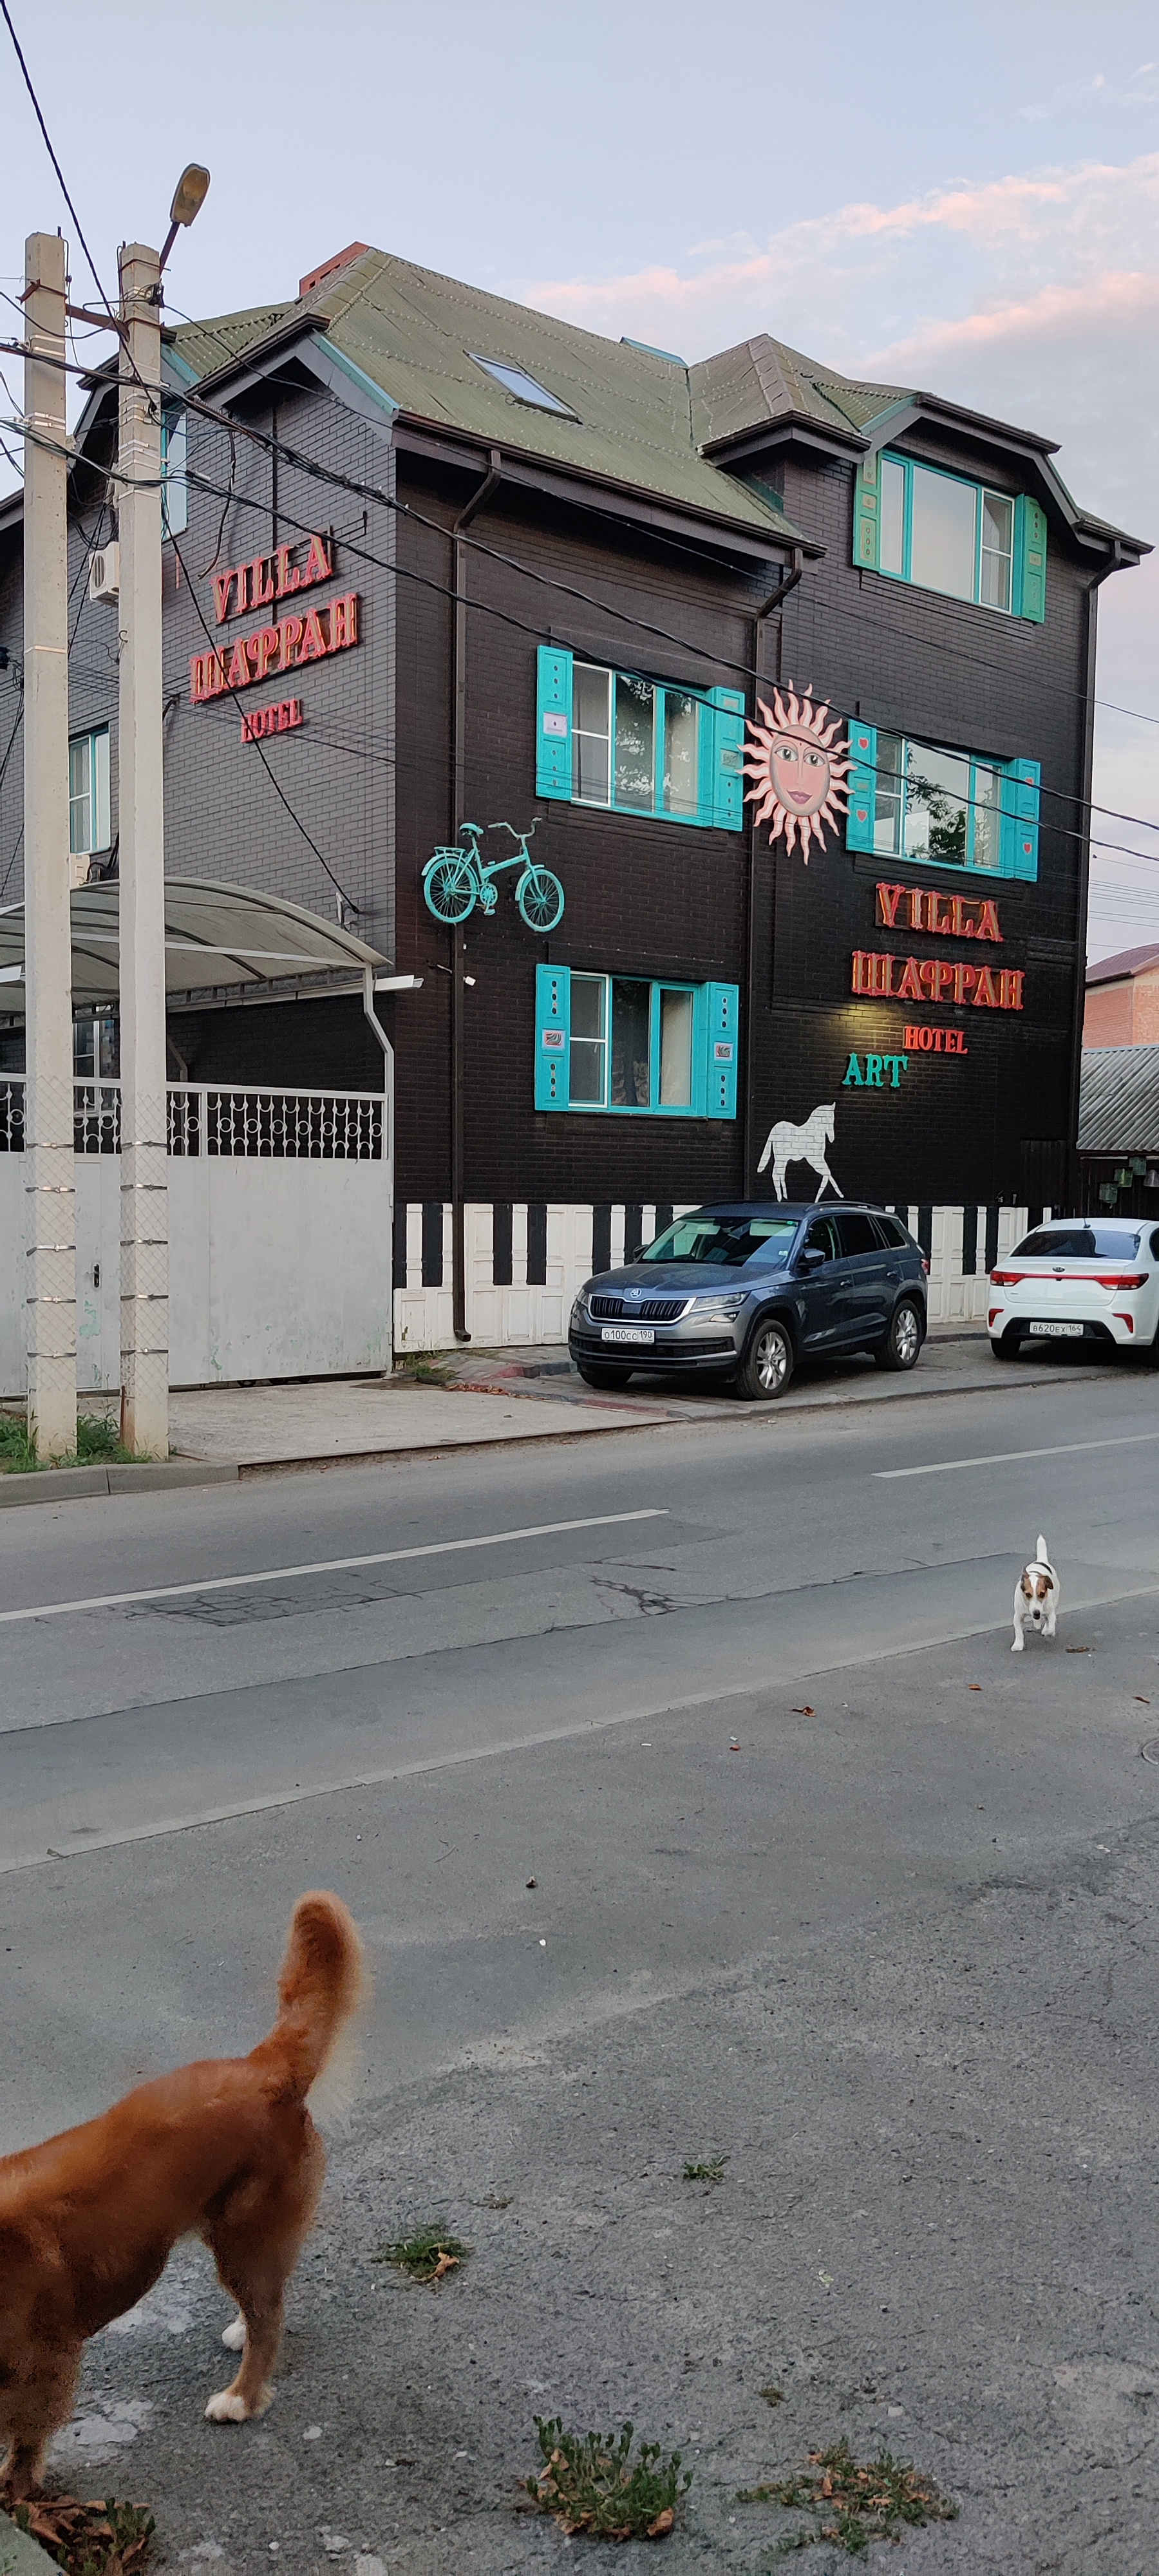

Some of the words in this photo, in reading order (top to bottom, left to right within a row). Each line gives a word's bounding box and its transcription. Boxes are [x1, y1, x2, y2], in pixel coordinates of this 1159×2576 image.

[209, 529, 332, 623] VILLA
[189, 592, 358, 704] ШАФРАН
[240, 698, 303, 743] HOTEL
[876, 882, 1004, 942] VILLA
[851, 950, 1025, 1010] ШАФРАН
[903, 1025, 968, 1054] HOTEL
[842, 1052, 909, 1088] ART
